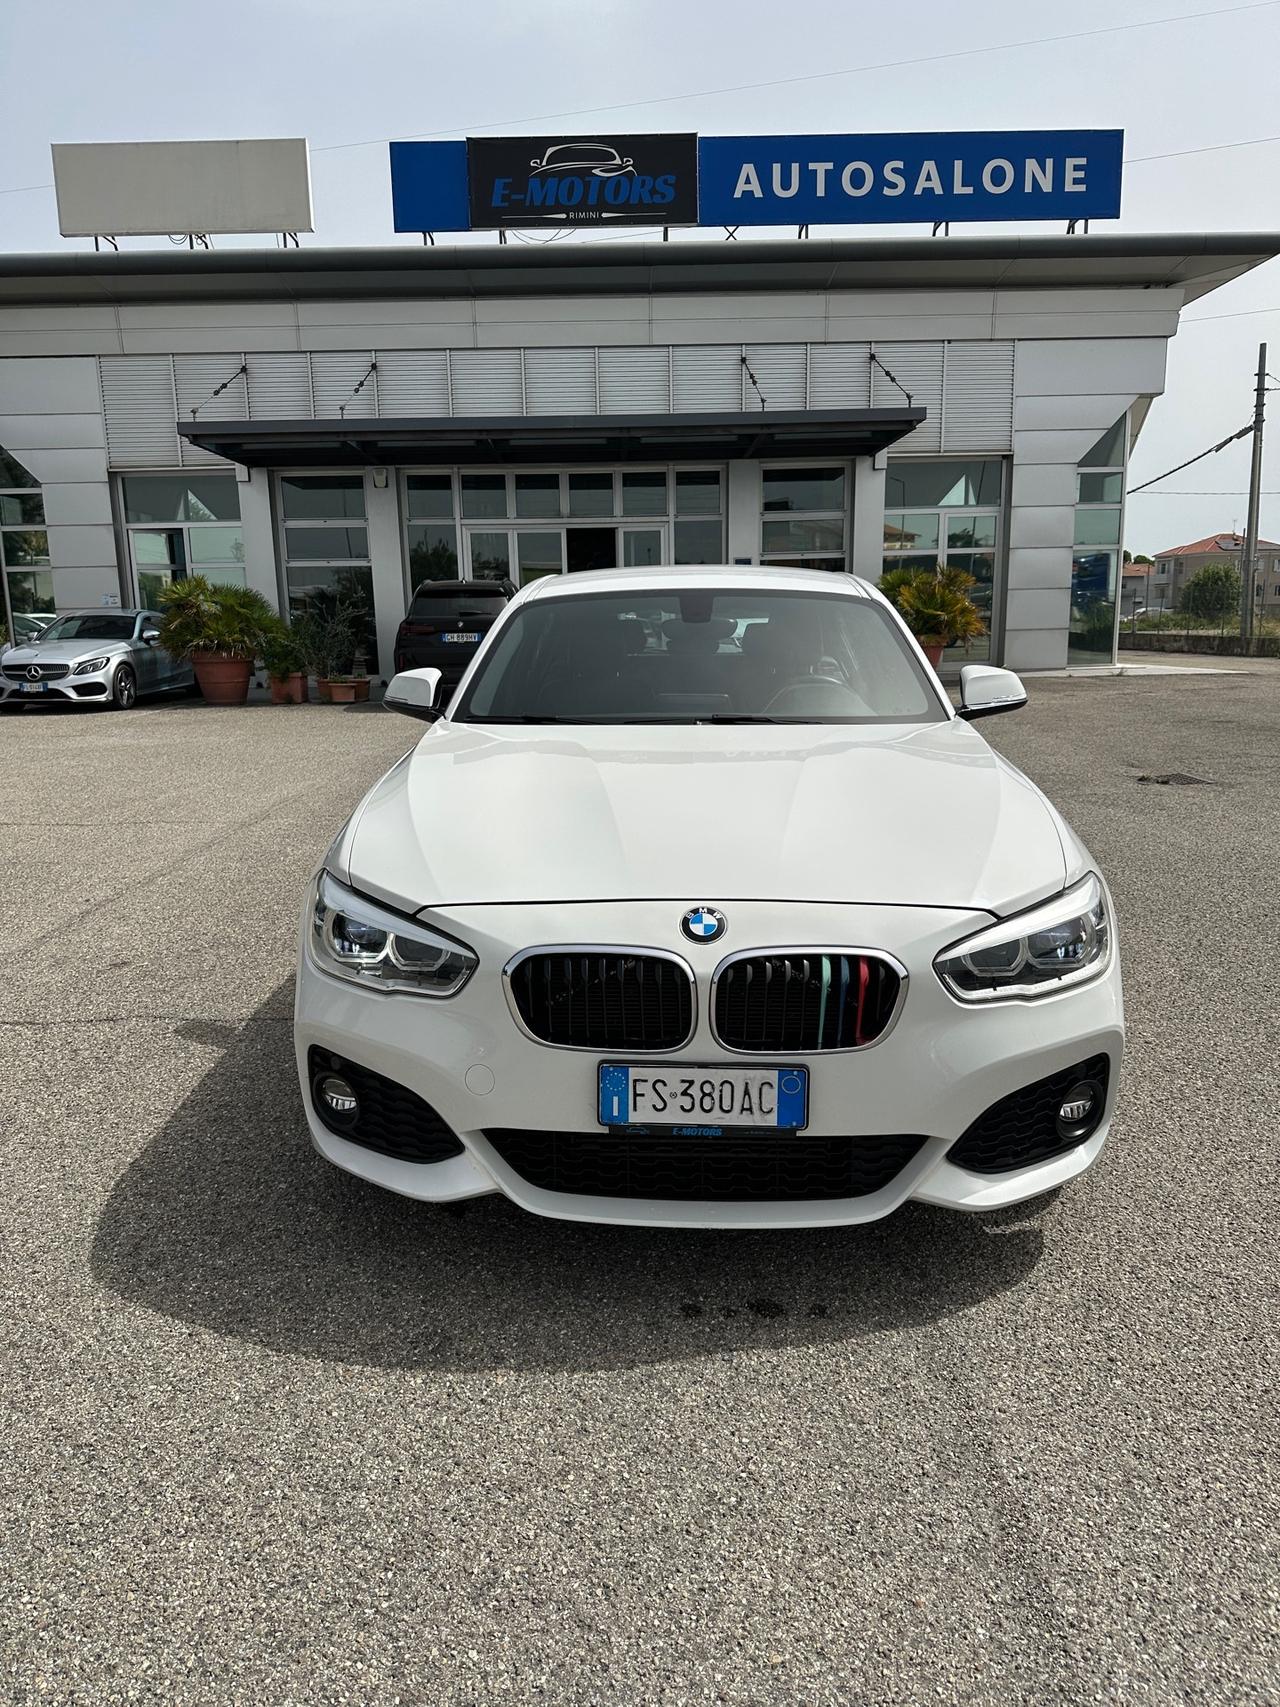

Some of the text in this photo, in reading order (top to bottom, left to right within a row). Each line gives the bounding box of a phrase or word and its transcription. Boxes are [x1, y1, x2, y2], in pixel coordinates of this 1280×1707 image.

[733, 157, 1087, 198] AUTOSALONE
[491, 174, 676, 207] E-MOTORS
[569, 211, 600, 219] RIMINI
[686, 907, 722, 918] BMW
[672, 1127, 723, 1136] E-MOTORS
